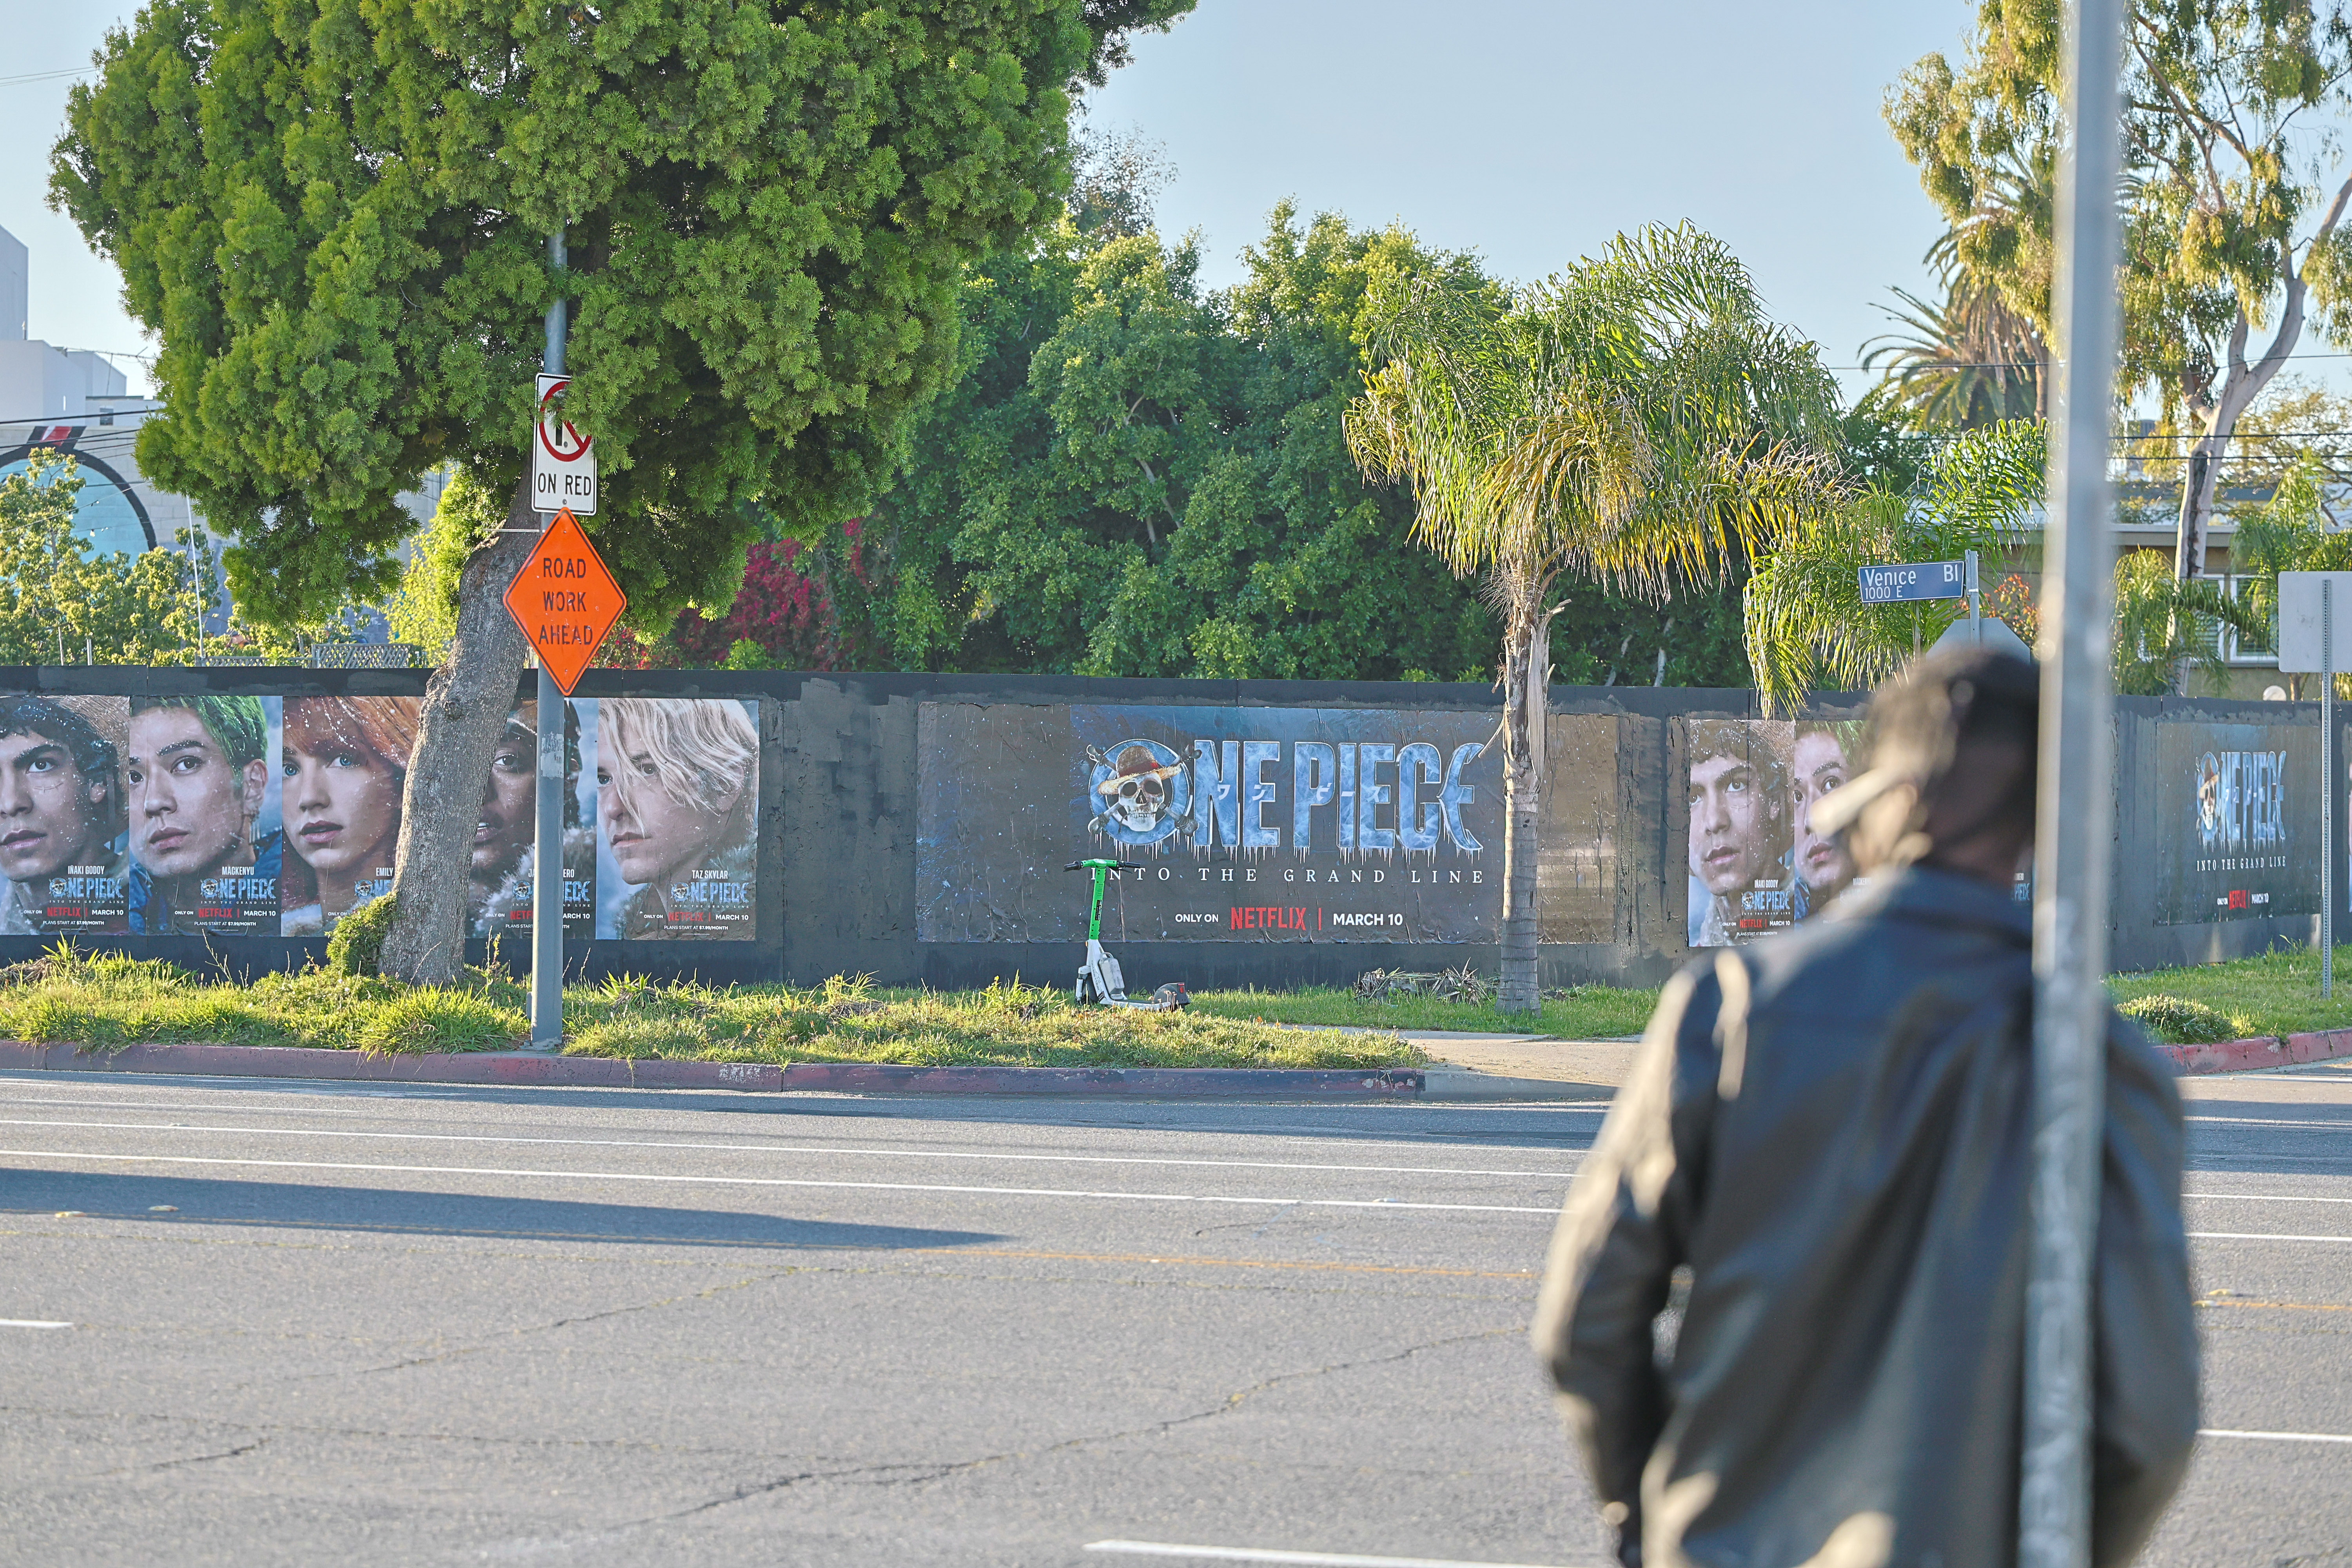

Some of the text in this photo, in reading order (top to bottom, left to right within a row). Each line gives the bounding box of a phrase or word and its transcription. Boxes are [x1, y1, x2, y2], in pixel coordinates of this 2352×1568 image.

[538, 473, 592, 496] ON RED
[544, 558, 586, 578] ROAD
[1865, 569, 1916, 587] Venice
[1865, 586, 1903, 599] 1000 E
[543, 591, 586, 612] WORK
[539, 624, 593, 645] AHEAD
[1088, 739, 1484, 851] ONE PIECE
[2196, 751, 2286, 841] ONE PIECE
[68, 865, 105, 874] IÑAKI GODOY
[222, 866, 254, 875] MACKENYU
[376, 867, 394, 876] EMILY
[2197, 856, 2286, 871] INTO THE GRAND LINE
[692, 870, 728, 879] TAZ SKYLAR
[1091, 867, 1483, 884] INTO THE GRAND LINE
[49, 877, 124, 898] ONE PIECE
[200, 878, 276, 899] ONE PIECE
[563, 881, 590, 901] ECE
[1754, 879, 1778, 888] IÑAKI GODOY
[671, 882, 749, 903] ONE PIECE
[1741, 891, 1790, 910] ONE PIECE
[47, 907, 81, 916] NETFLIX
[198, 908, 232, 918] NETFLIX
[510, 910, 533, 920] NETF
[668, 912, 704, 921] NETFLIX
[1175, 914, 1218, 923] ONLY ON
[1231, 907, 1307, 930] NETFLIX
[1333, 914, 1403, 926] MARCH 10
[1740, 919, 1762, 928] NETFLIX
